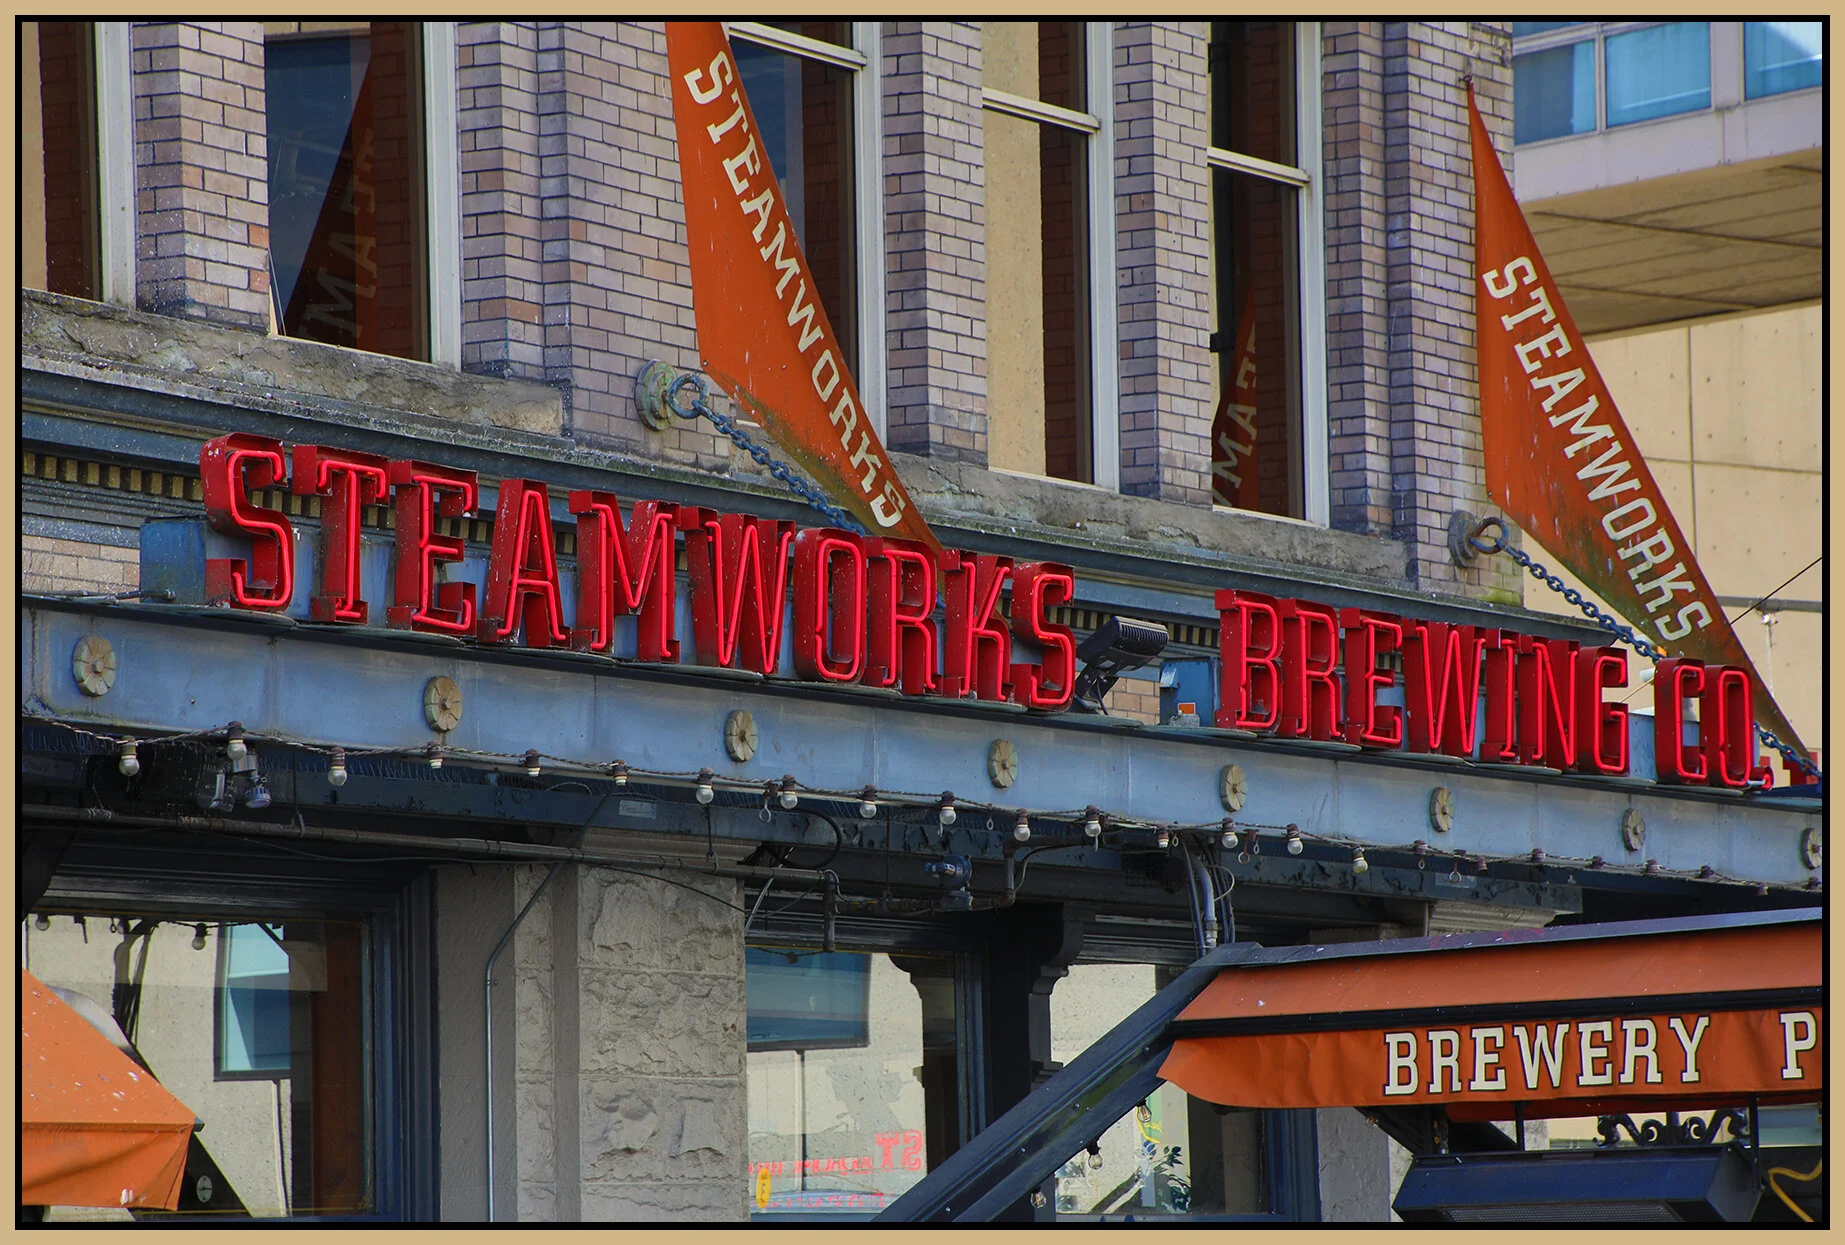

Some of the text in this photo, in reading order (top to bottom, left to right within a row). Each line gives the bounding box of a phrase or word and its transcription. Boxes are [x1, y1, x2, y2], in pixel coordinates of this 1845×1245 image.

[684, 50, 906, 527] STEAMWORKS
[1482, 256, 1713, 641] STEAMWORKS
[200, 432, 1074, 712] STEAMWORKS
[1215, 589, 1630, 776] BREWING
[1383, 1016, 1709, 1095] BREWERY
